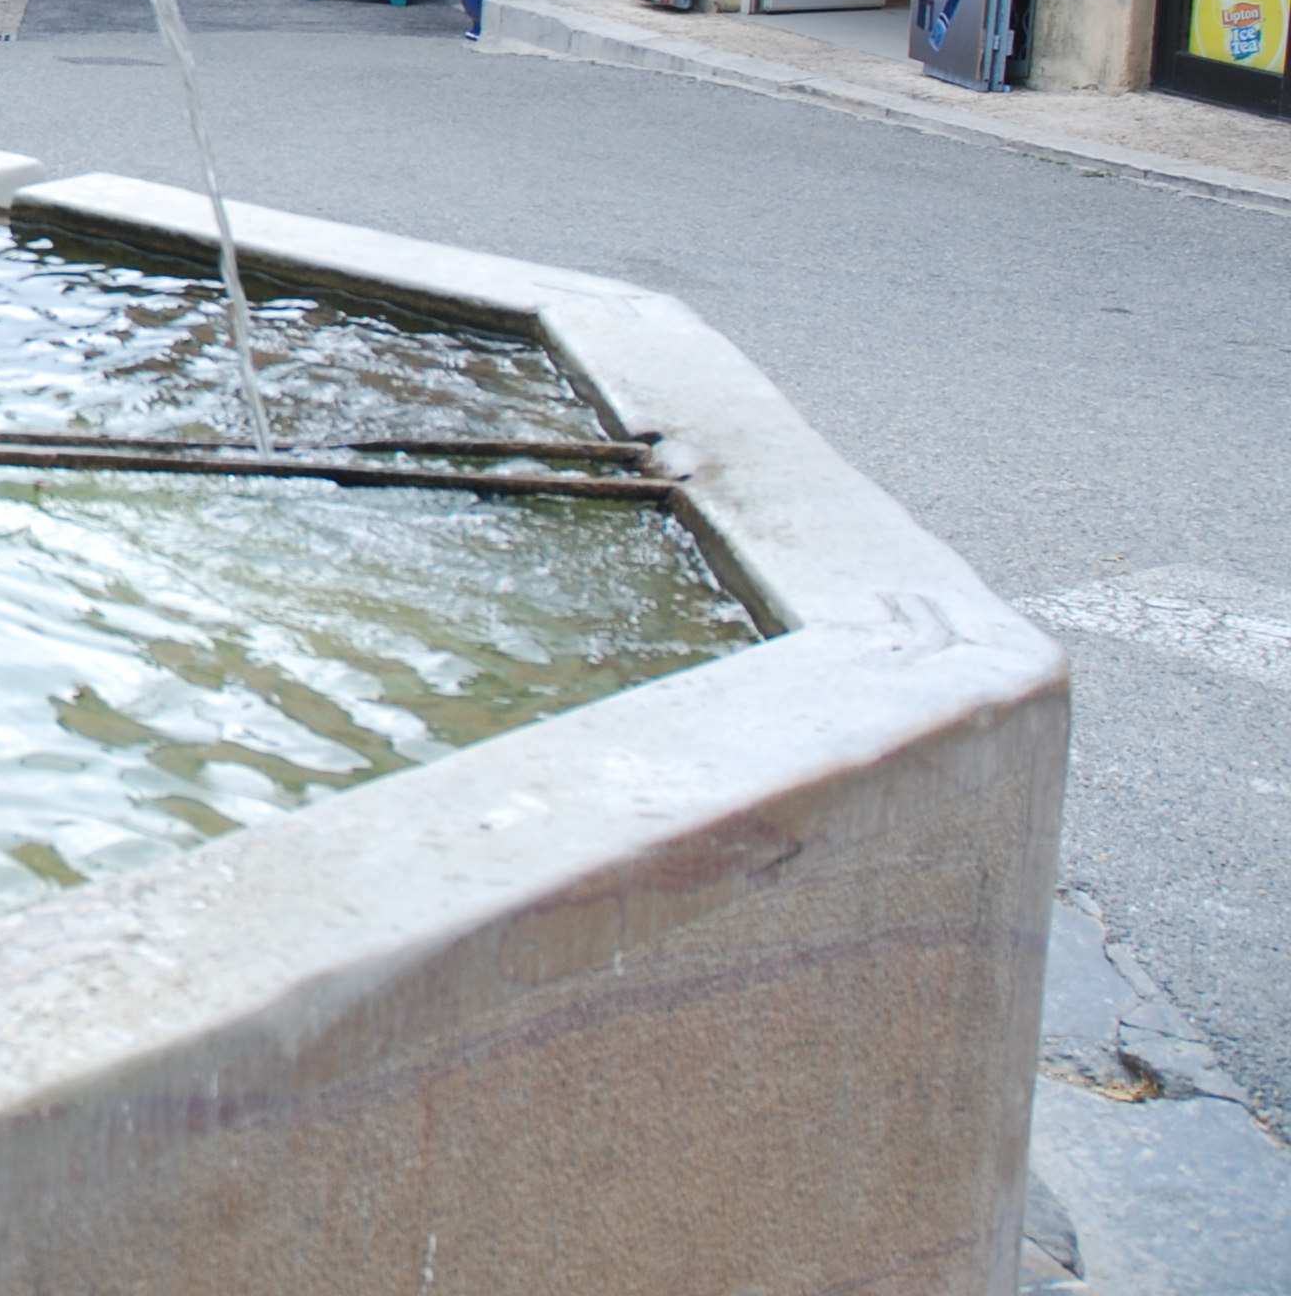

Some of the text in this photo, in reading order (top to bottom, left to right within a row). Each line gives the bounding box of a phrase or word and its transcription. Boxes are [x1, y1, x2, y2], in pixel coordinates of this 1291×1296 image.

[1223, 8, 1259, 23] Lipton
[1231, 27, 1257, 41] Ice
[1231, 40, 1259, 55] Tea
